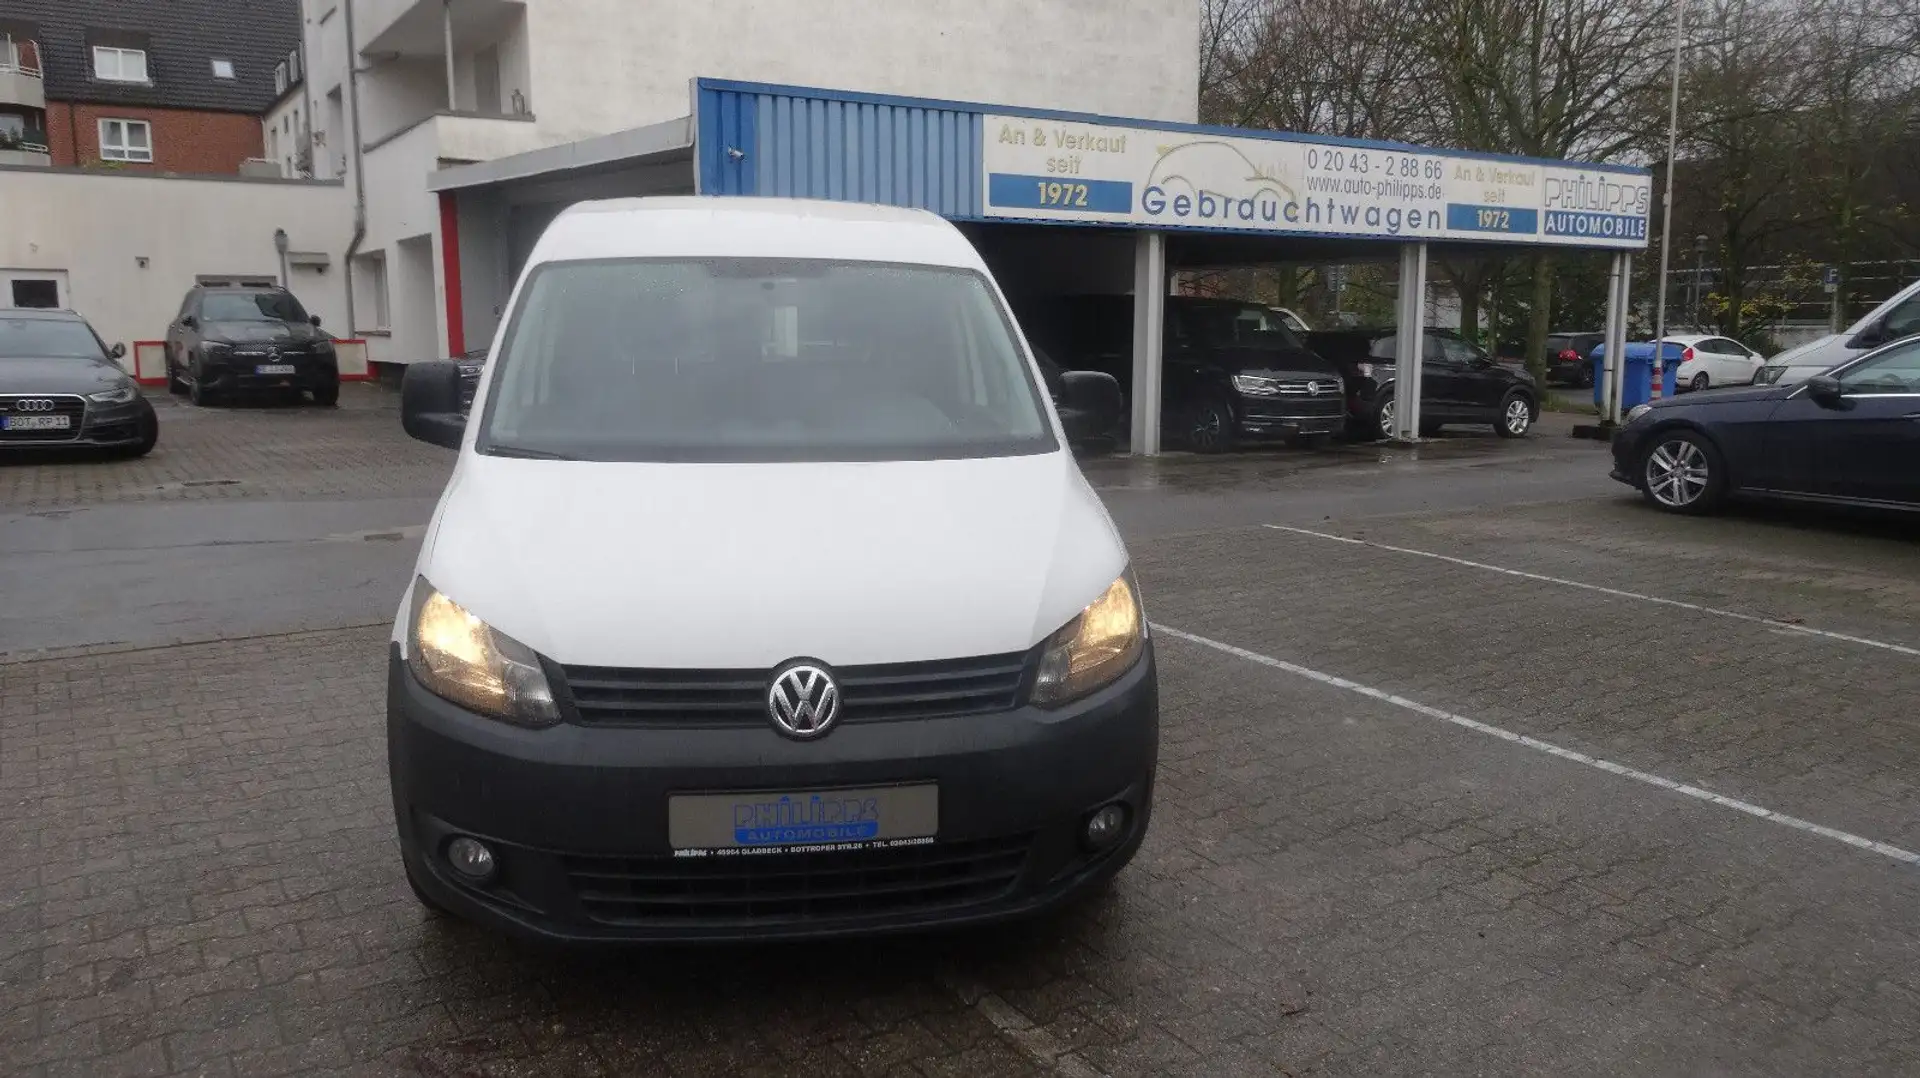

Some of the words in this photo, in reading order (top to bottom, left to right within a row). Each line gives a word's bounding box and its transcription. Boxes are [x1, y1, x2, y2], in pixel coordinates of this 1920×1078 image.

[999, 125, 1025, 144] An
[1033, 129, 1047, 147] &
[1053, 129, 1126, 154] Verkauf
[1046, 155, 1082, 174] seit
[1307, 148, 1318, 170] 0
[1323, 150, 1344, 172] 20
[1349, 153, 1369, 174] 43
[1385, 156, 1395, 176] 2
[1400, 158, 1419, 178] 88
[1424, 159, 1443, 180] 66
[1453, 165, 1472, 181] An
[1475, 168, 1484, 182] &
[1038, 181, 1089, 207] 1972
[1306, 176, 1442, 201] www.auto-philipps.de
[1142, 186, 1441, 234] Gebrauchtwagen
[1476, 209, 1511, 230] 1972
[1544, 216, 1647, 238] AUTOMOBILE
[747, 826, 868, 841] AUTOMOBILE
[741, 846, 782, 855] GLADBECK
[790, 844, 835, 853] BOTTROPER
